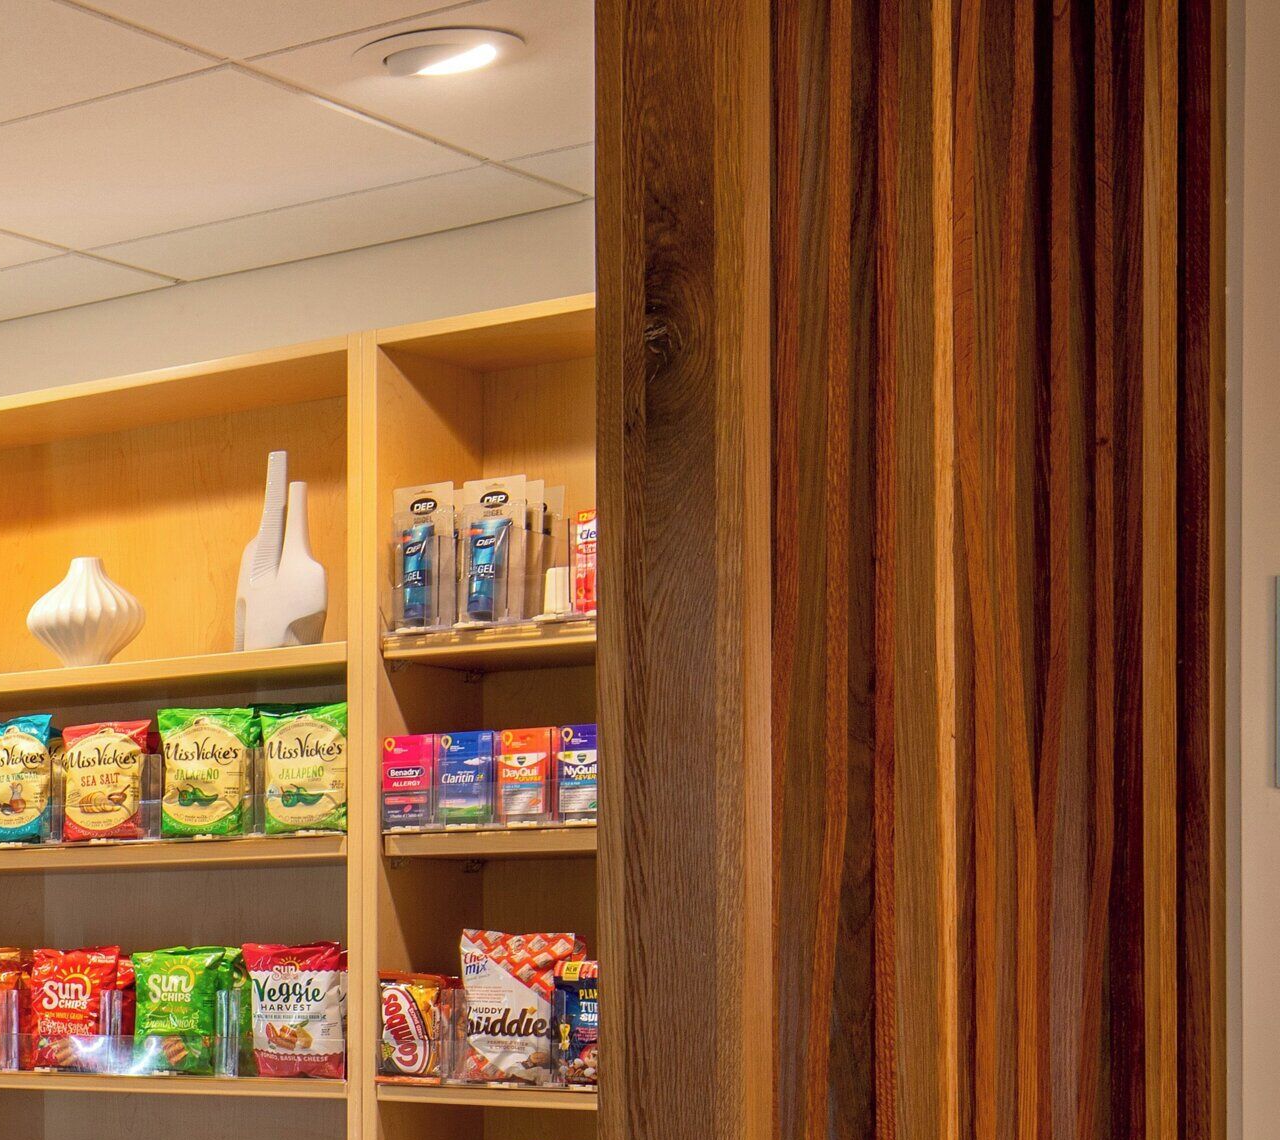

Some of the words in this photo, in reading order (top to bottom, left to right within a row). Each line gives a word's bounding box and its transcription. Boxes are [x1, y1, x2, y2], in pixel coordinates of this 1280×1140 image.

[414, 502, 434, 512] DEP
[484, 495, 505, 504] DEP
[194, 737, 240, 766] Vickie's
[268, 740, 297, 759] Miss
[296, 733, 343, 762] Vickie's
[3, 744, 45, 769] Vickie's
[68, 752, 96, 769] Miss
[96, 743, 137, 769] Vickie's
[278, 764, 325, 780] JALAPEÑO
[441, 773, 474, 785] Claritin
[563, 764, 597, 778] NyQuil
[81, 775, 97, 788] SEA
[99, 772, 120, 786] SALT
[272, 965, 296, 981] Sun
[465, 961, 488, 975] mix
[566, 965, 578, 973] NEW
[42, 981, 90, 1010] Sun
[147, 973, 193, 1003] Sun
[252, 976, 326, 1003] Veggie
[58, 1000, 87, 1010] CHIPS
[161, 992, 191, 1002] CHIPS
[472, 1007, 503, 1015] MUDDY
